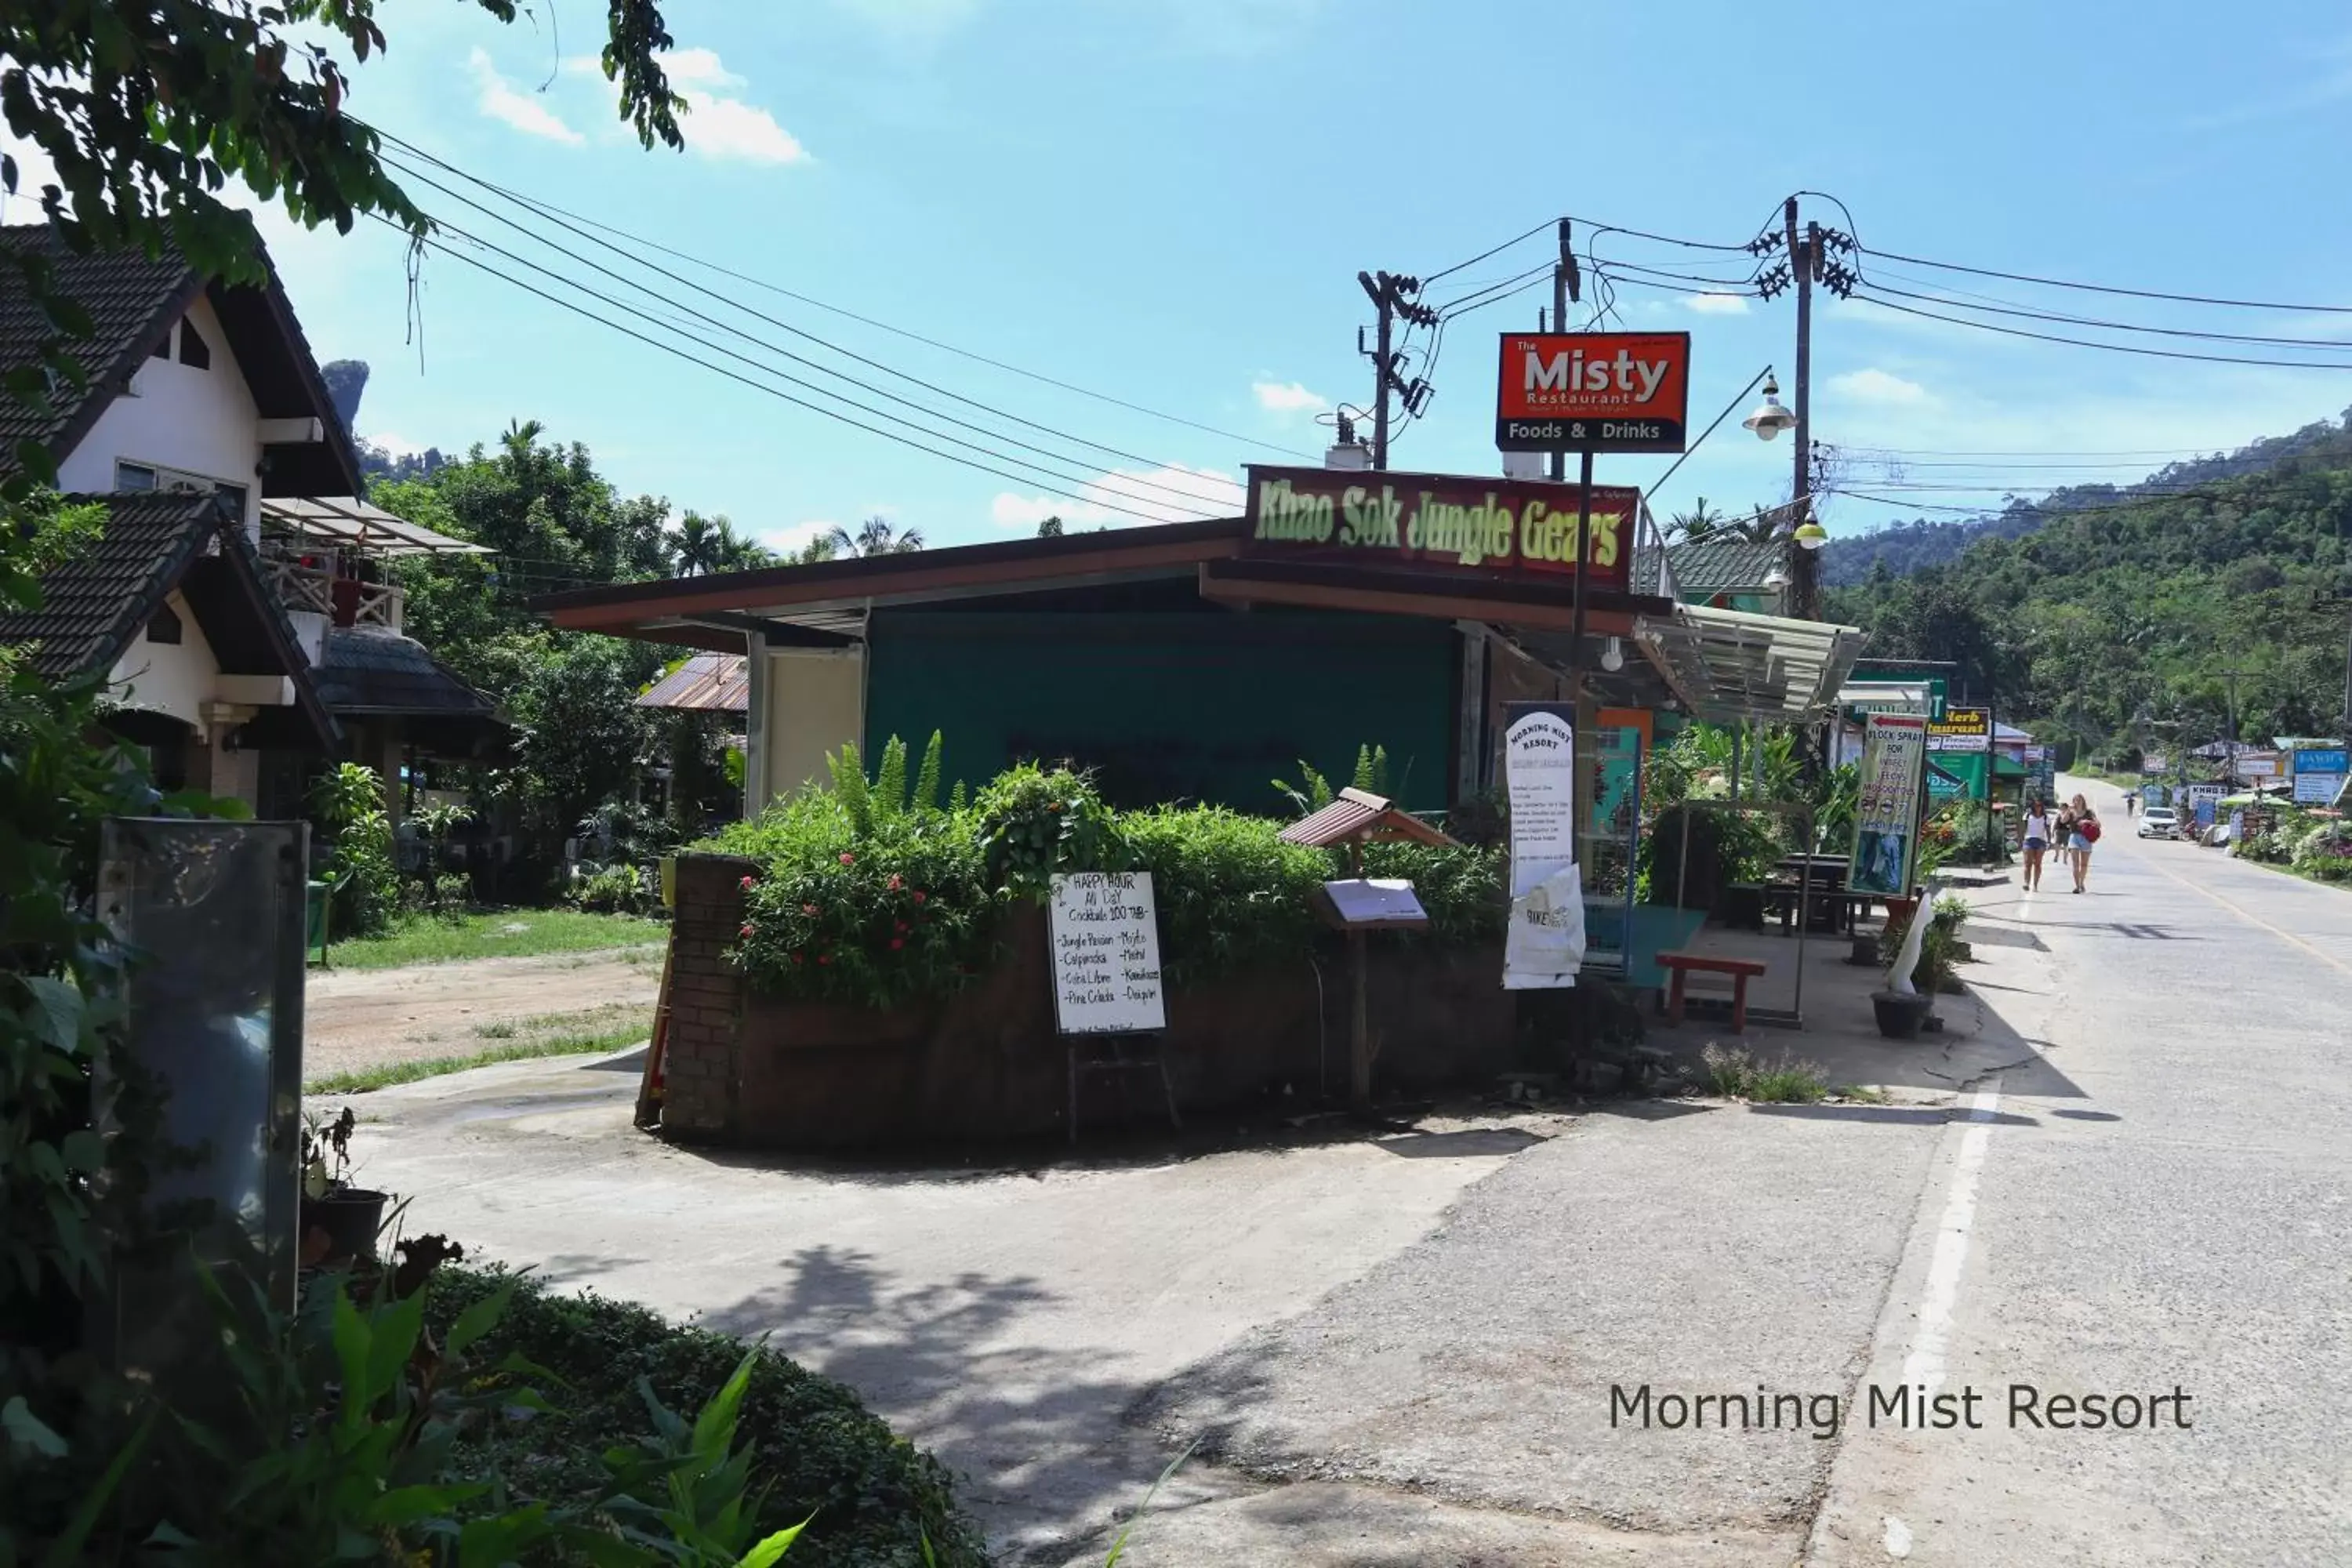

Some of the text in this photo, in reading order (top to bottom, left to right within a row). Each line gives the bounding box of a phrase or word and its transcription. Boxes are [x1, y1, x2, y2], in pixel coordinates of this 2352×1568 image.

[1518, 341, 1536, 350] The
[1525, 350, 1668, 402] Misty
[1527, 393, 1630, 405] Restaurant
[1509, 423, 1660, 438] Foods & Drinks
[1254, 479, 1621, 566] Khao Sok Jungle Gears
[1511, 724, 1570, 746] MORNING MIST
[1523, 739, 1559, 750] RESORT
[1887, 745, 1903, 753] FOR
[1074, 873, 1135, 890] HAPPY HOUR
[1109, 906, 1127, 920] 100
